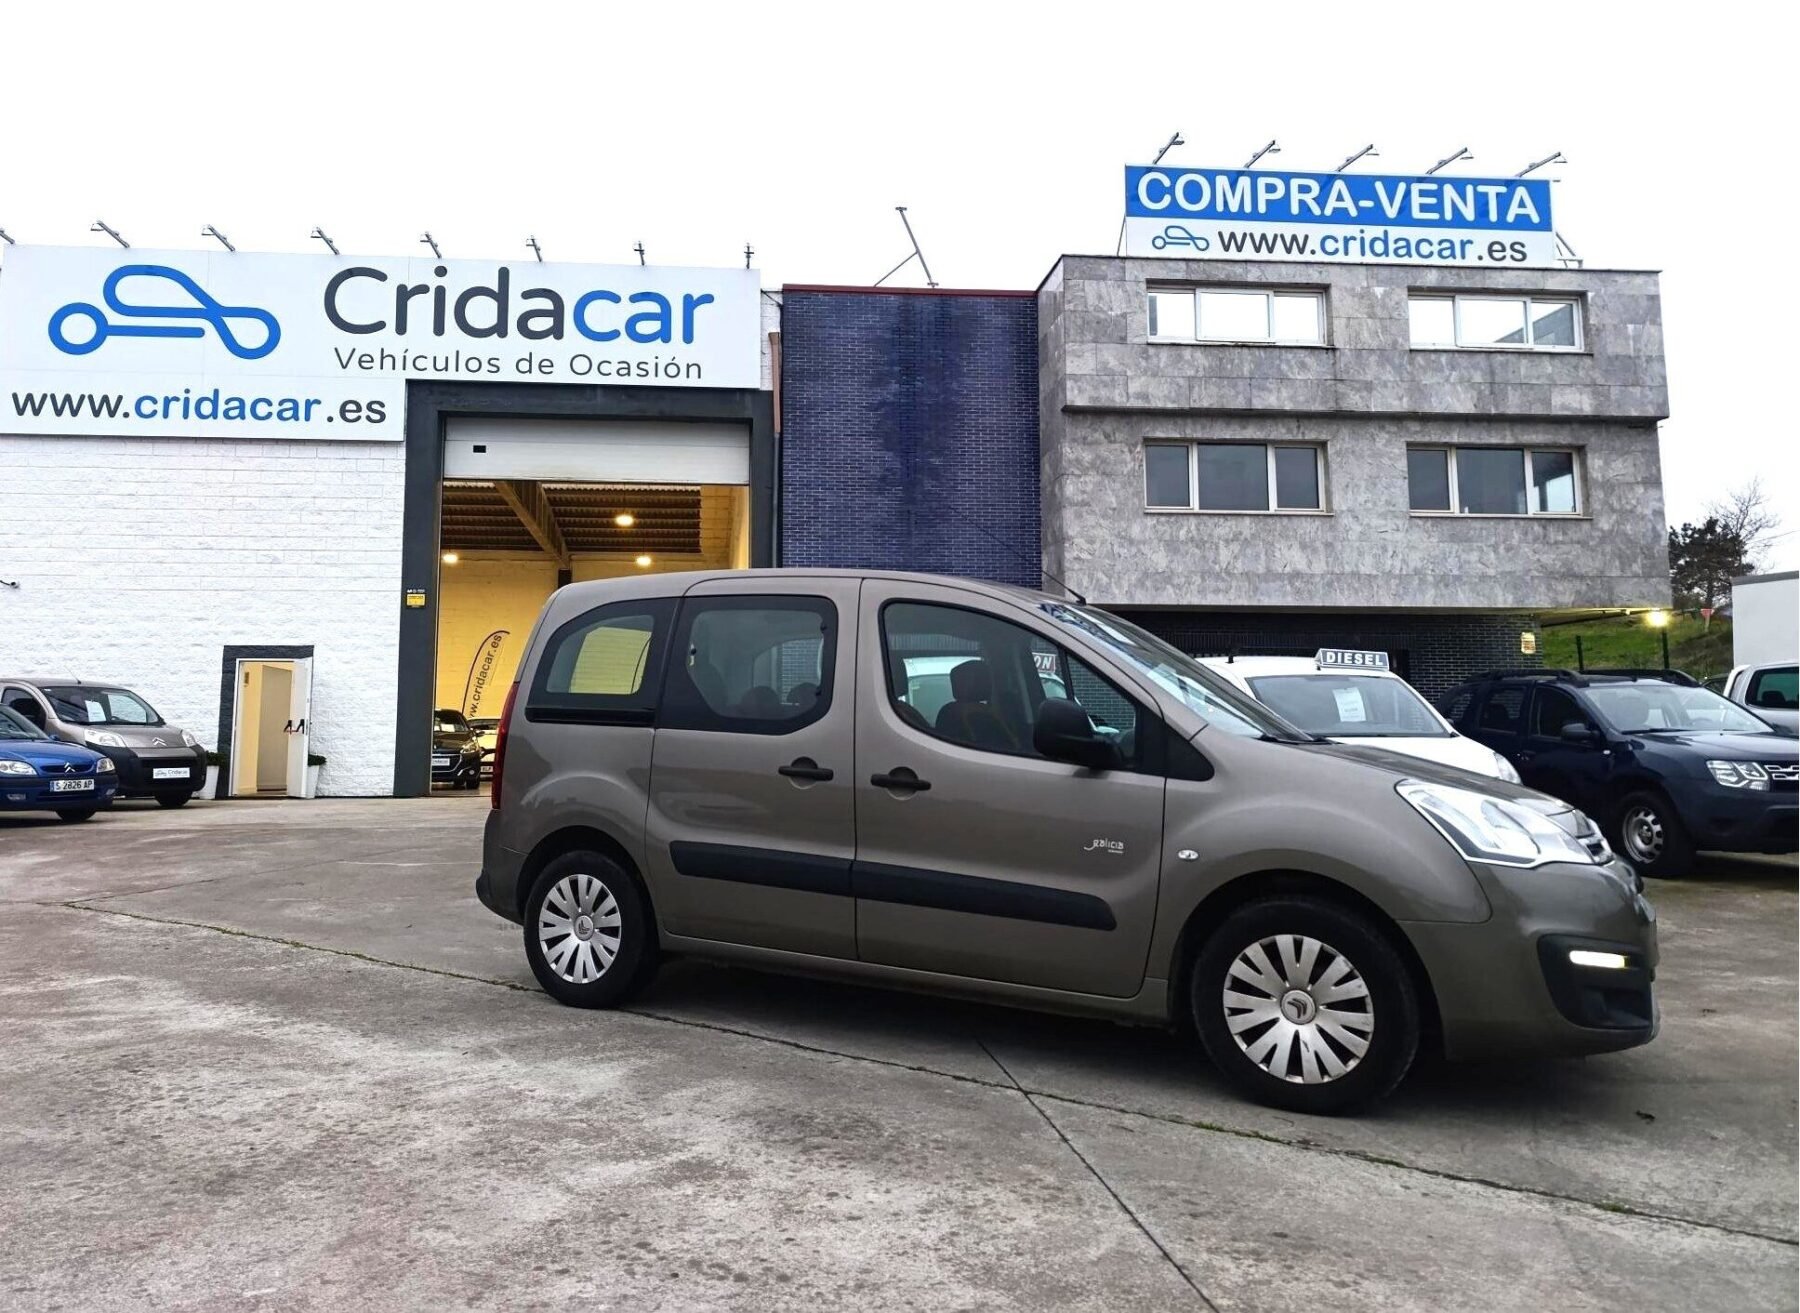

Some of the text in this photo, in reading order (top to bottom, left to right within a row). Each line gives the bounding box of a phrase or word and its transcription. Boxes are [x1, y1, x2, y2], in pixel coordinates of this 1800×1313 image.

[1137, 171, 1540, 224] COMPRA-VENTA
[1217, 229, 1528, 263] www.cridacar.es
[323, 266, 715, 345] Cridacar
[334, 346, 702, 380] Vehículos de Ocasión
[11, 388, 387, 424] www.cridacar.es
[1326, 651, 1383, 666] DIESEL
[63, 780, 82, 790] 2826
[83, 780, 93, 789] AP
